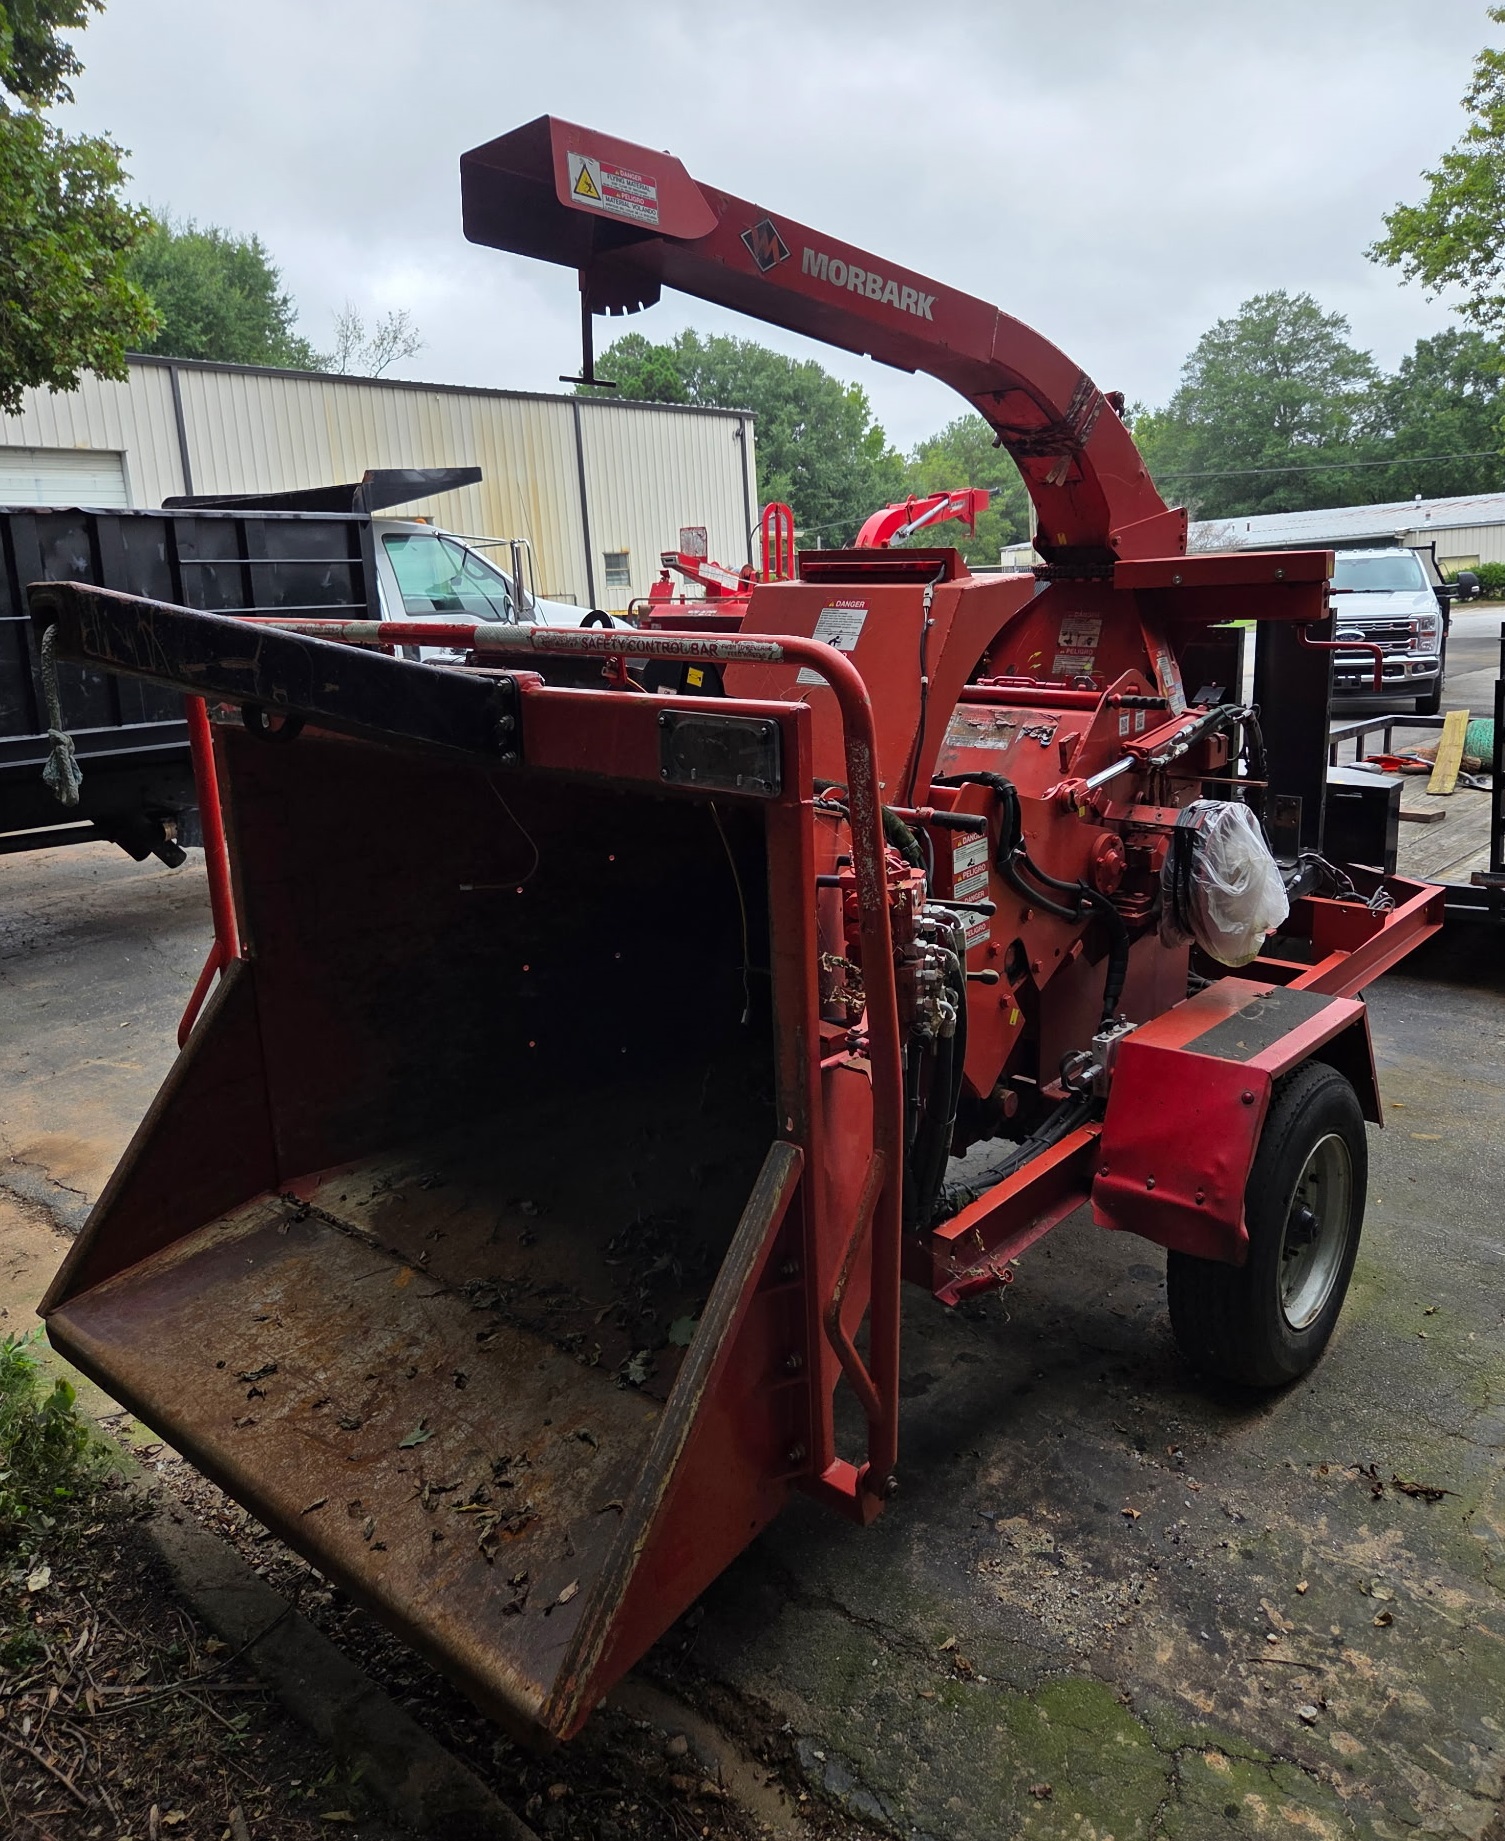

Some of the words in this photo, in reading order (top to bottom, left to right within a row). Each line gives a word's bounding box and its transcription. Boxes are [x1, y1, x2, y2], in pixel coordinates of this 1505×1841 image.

[619, 170, 642, 182] DANGER
[626, 177, 651, 192] MATERIAL
[605, 196, 631, 209] MATERIAL
[632, 203, 657, 216] VOLANDO
[621, 192, 645, 205] PELIGRO
[802, 247, 934, 321] MORBARK
[835, 600, 865, 608] DANGER
[581, 637, 625, 652] SAFETY
[690, 643, 719, 658] BAR
[962, 863, 986, 880] PELIGRO
